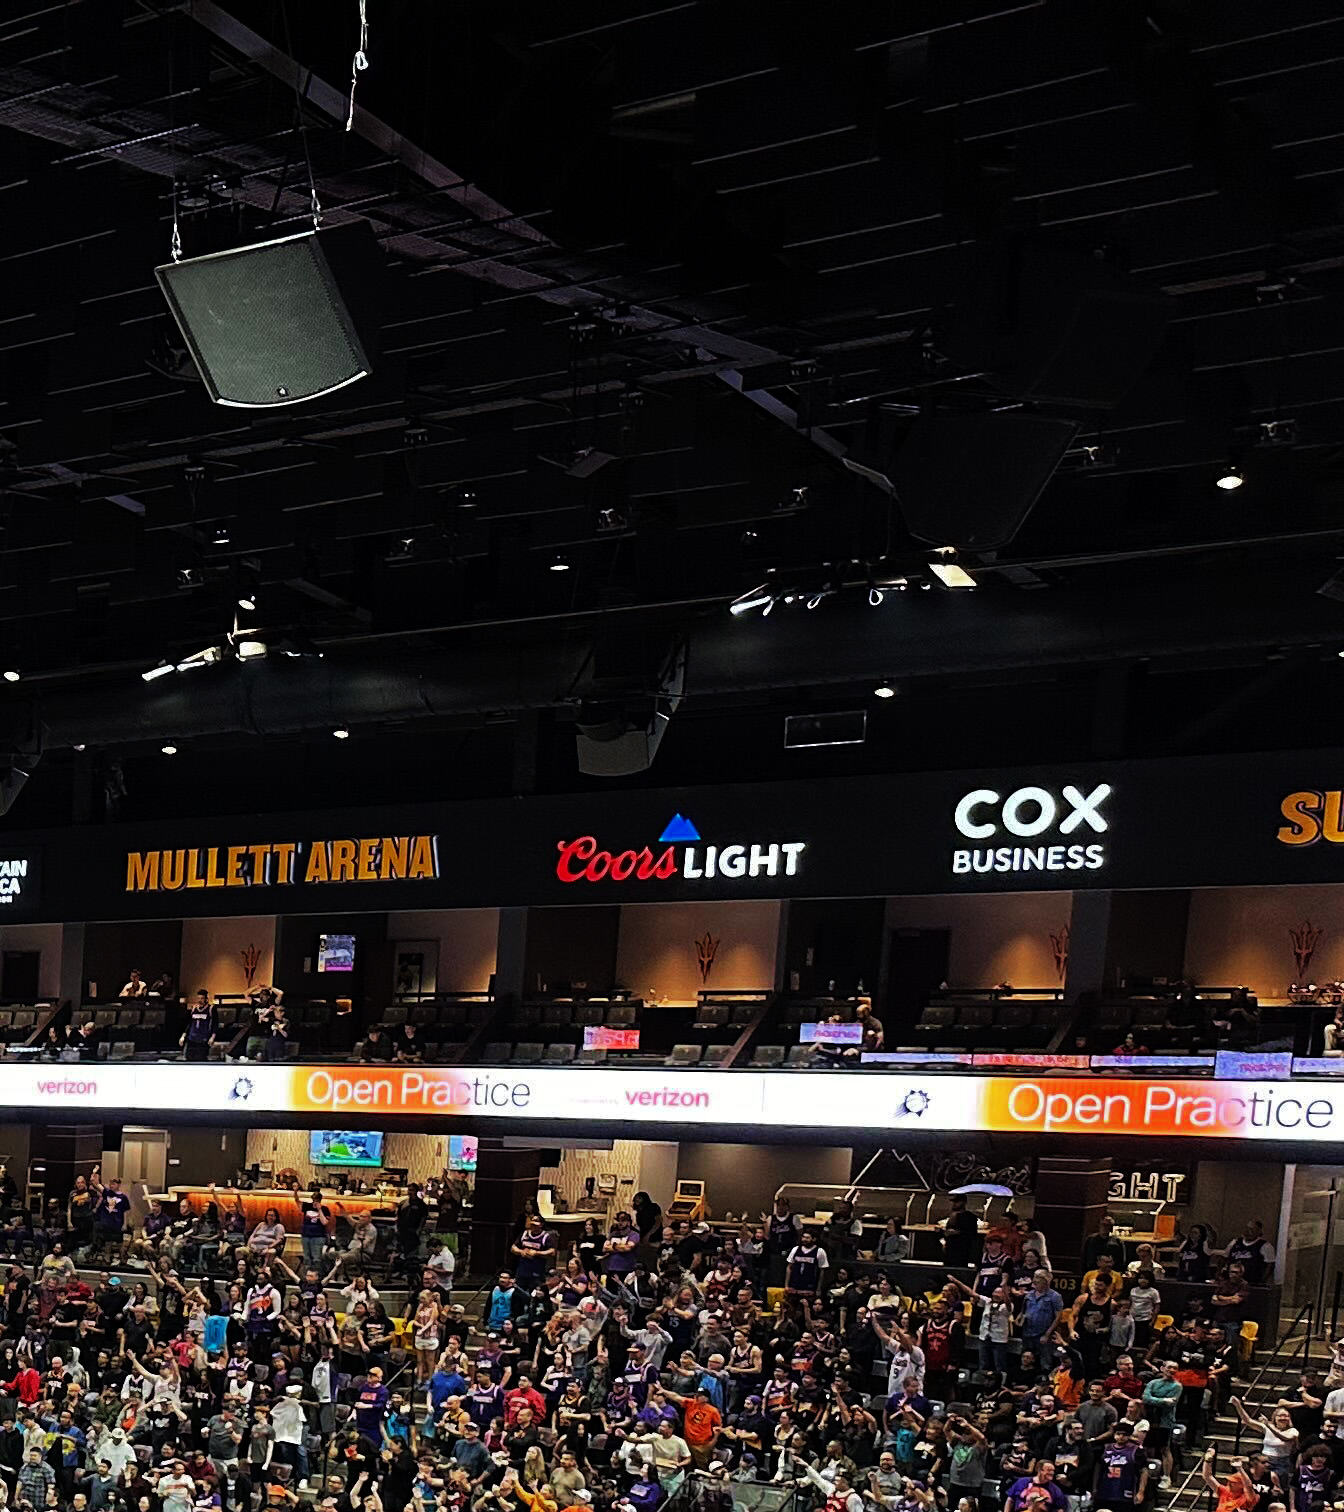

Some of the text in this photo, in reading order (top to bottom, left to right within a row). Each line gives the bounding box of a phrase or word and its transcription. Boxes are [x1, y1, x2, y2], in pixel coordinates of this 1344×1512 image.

[954, 783, 1112, 839] COX
[125, 834, 441, 892] MULLETT ARENA
[556, 836, 806, 882] Coors LIGHT
[952, 844, 1105, 874] BUSINESS
[37, 1078, 97, 1096] verizon
[307, 1071, 531, 1107] Open Practice
[625, 1087, 709, 1108] verizon
[1007, 1083, 1334, 1131] Open Practice
[1109, 1172, 1186, 1203] GHT
[1053, 1278, 1077, 1291] 103
